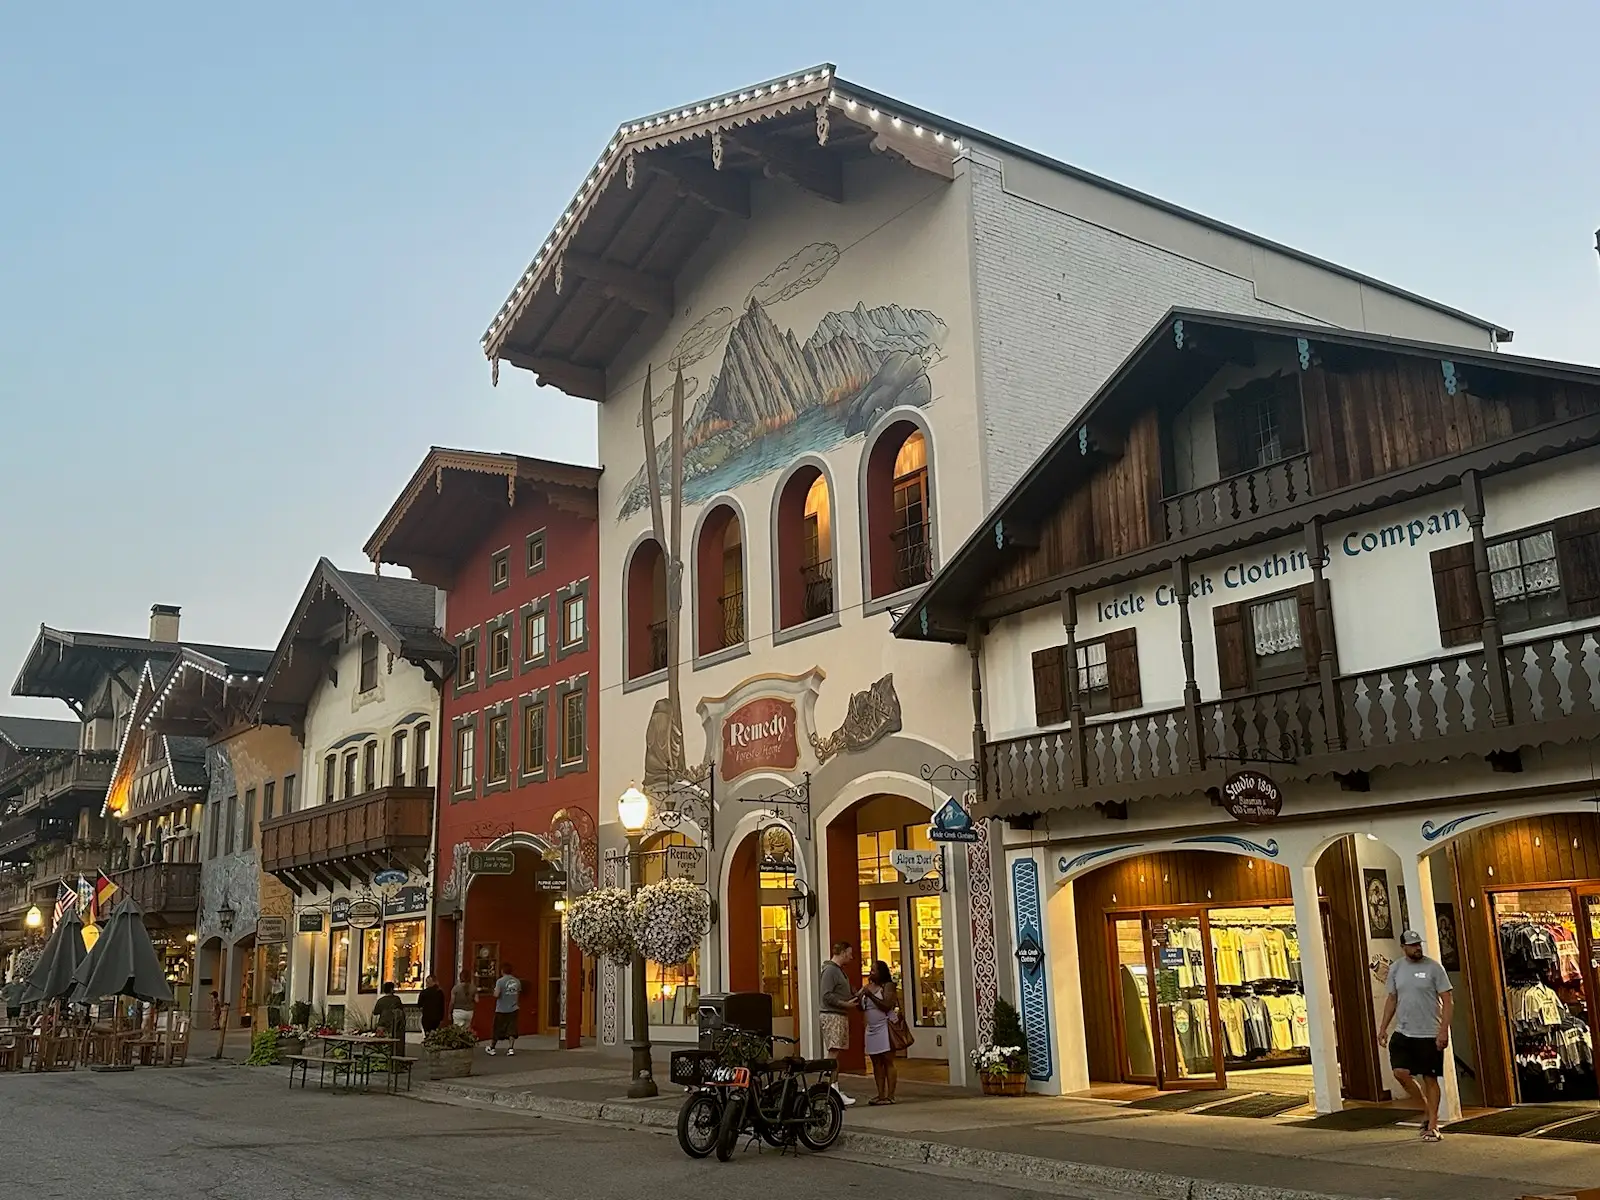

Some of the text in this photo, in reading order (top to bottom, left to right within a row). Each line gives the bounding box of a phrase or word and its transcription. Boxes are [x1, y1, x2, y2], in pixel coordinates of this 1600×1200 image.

[1097, 593, 1145, 623] Icicle
[1343, 508, 1469, 556] Compan
[730, 714, 787, 747] Remedy
[1226, 774, 1278, 800] Studio 1890
[670, 848, 703, 863] Remedy
[677, 861, 696, 869] Forest
